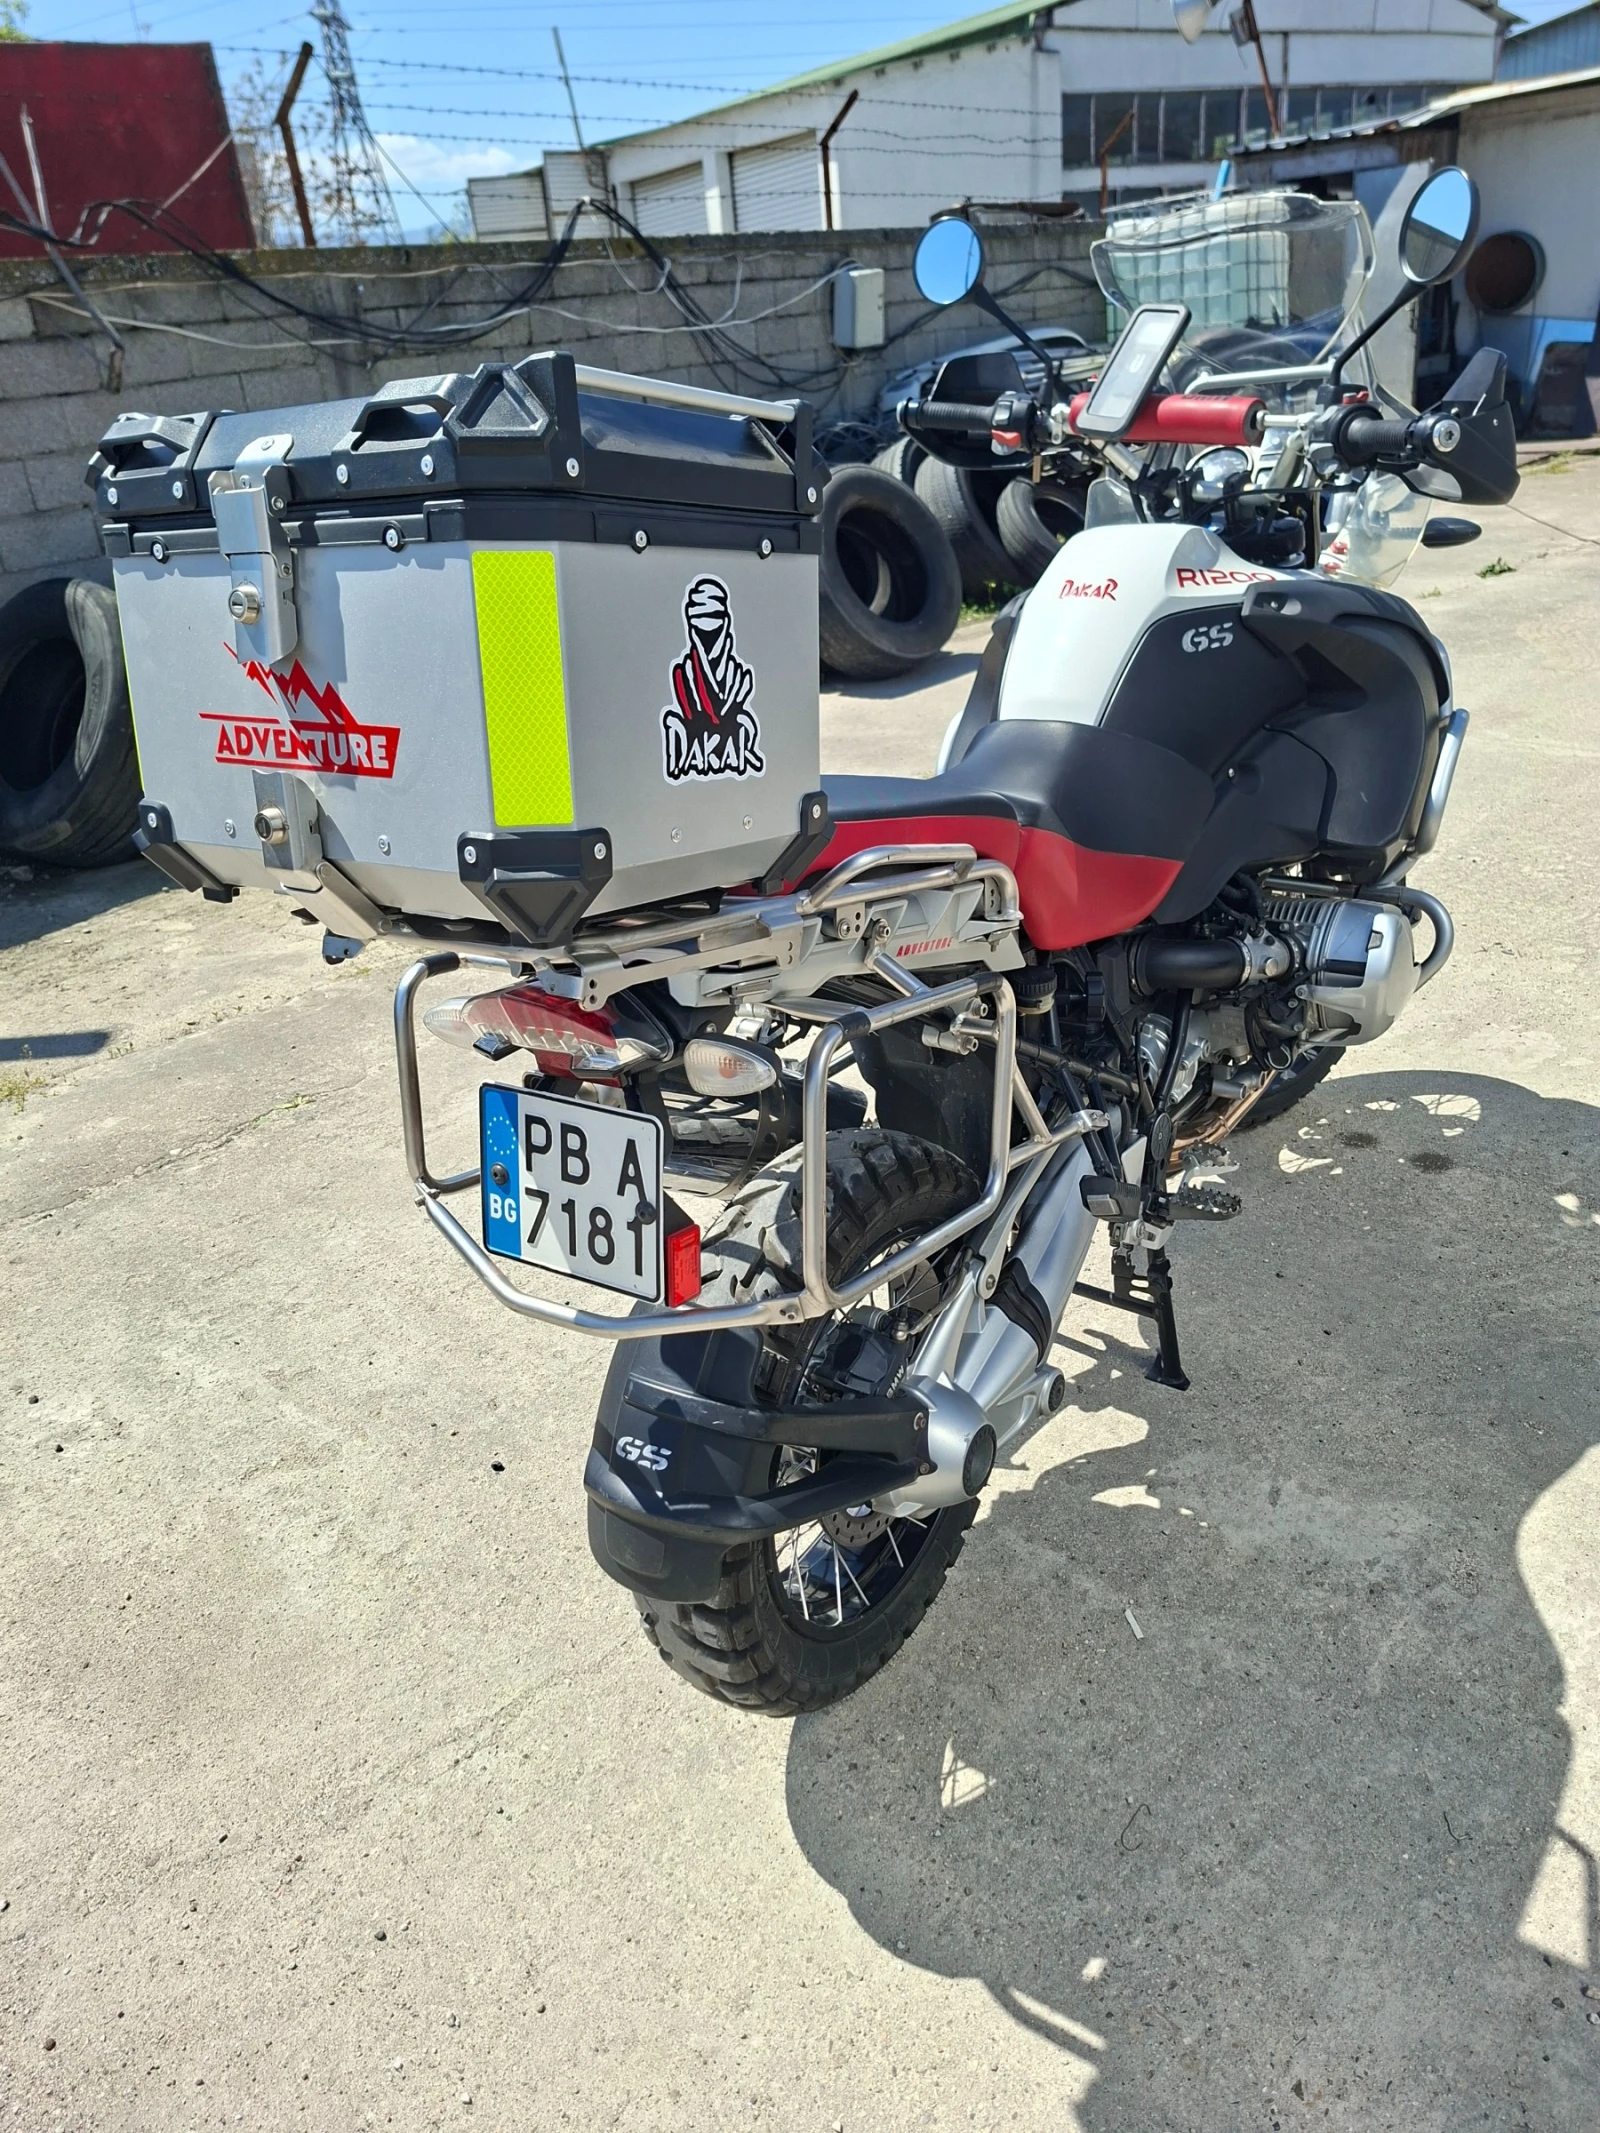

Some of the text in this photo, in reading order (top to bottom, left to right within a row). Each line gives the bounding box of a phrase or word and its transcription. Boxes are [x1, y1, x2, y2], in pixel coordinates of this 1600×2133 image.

[1058, 578, 1119, 601] DAKAR
[1175, 567, 1276, 588] R1200
[1181, 622, 1234, 653] GS
[216, 723, 391, 770] ADVENTURE
[664, 710, 764, 779] DAKAR
[895, 936, 954, 957] ADVENTURE
[524, 1113, 650, 1205] PB A
[489, 1193, 518, 1224] BG
[524, 1186, 644, 1277] 7181
[615, 1435, 673, 1472] GS
